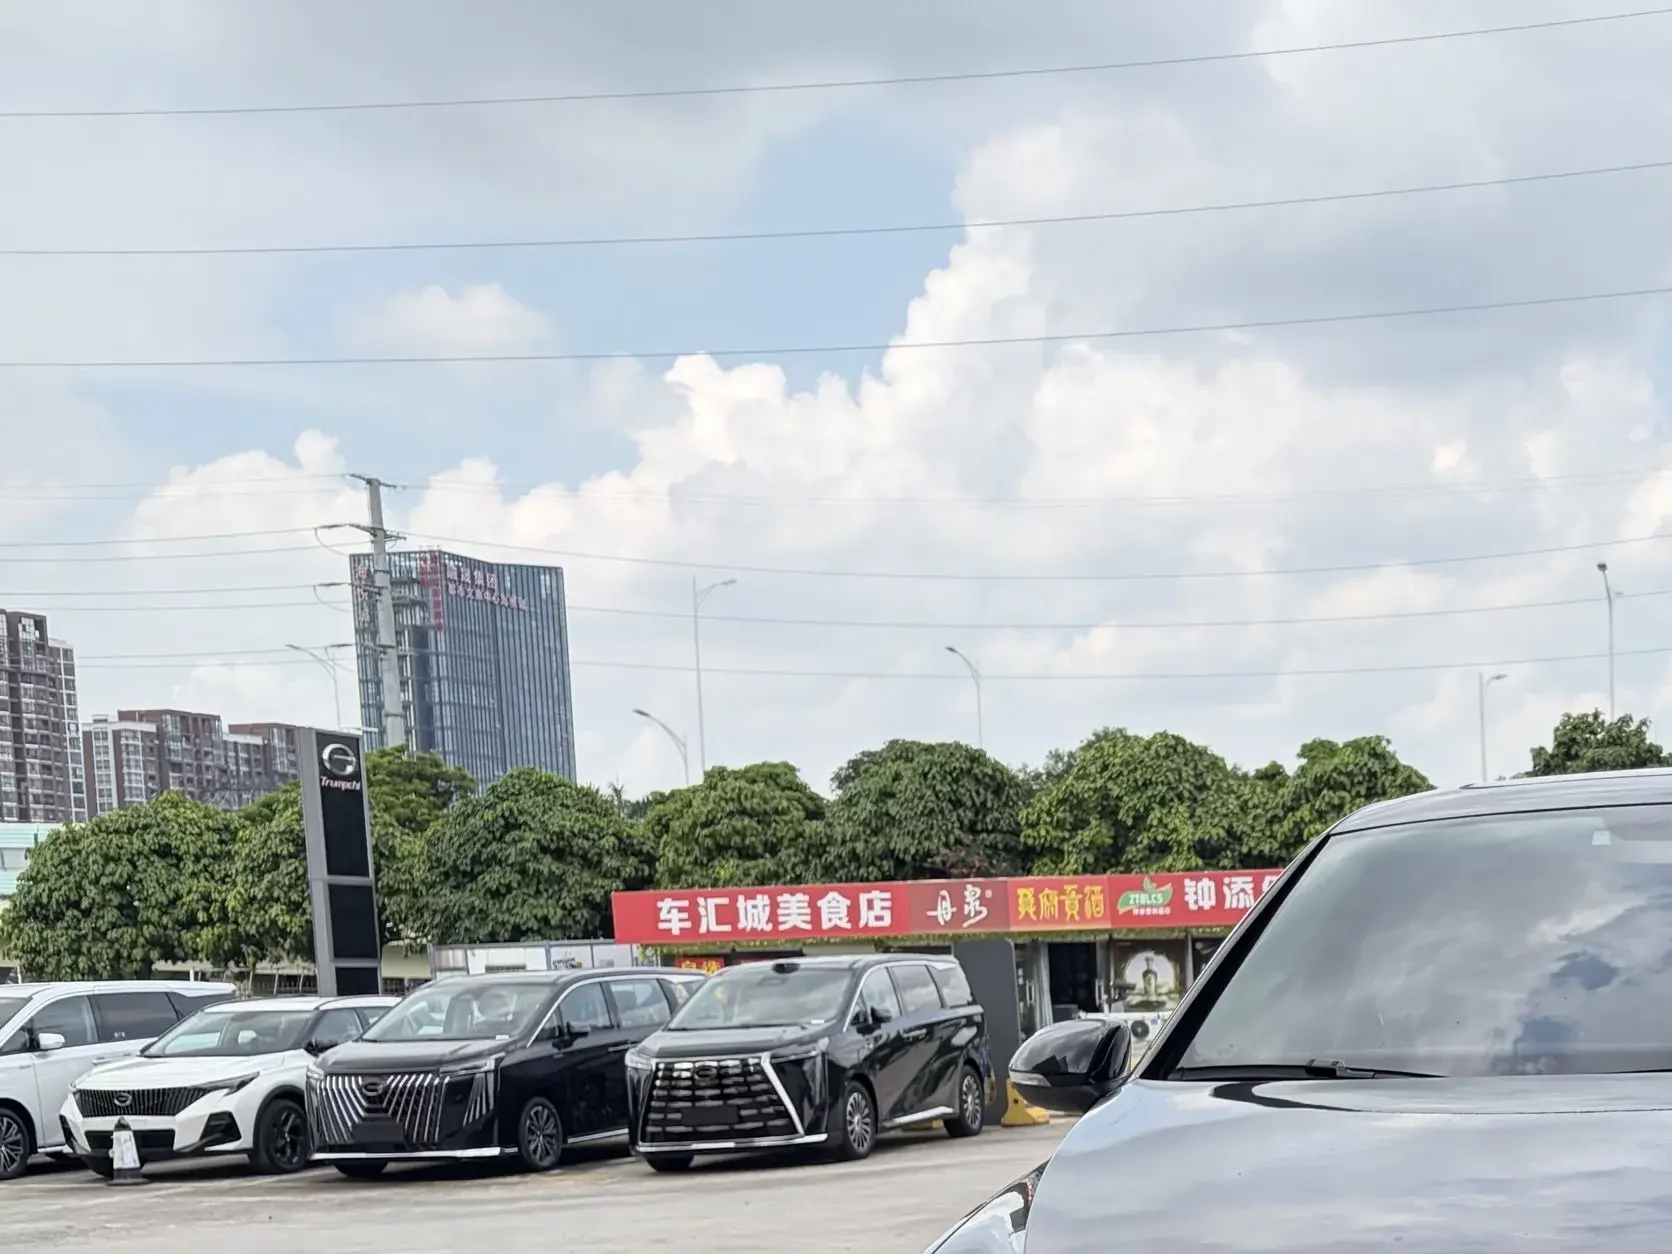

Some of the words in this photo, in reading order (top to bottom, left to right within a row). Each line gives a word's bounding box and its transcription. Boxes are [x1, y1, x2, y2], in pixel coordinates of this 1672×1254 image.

[656, 890, 893, 936] 车汇城美食店
